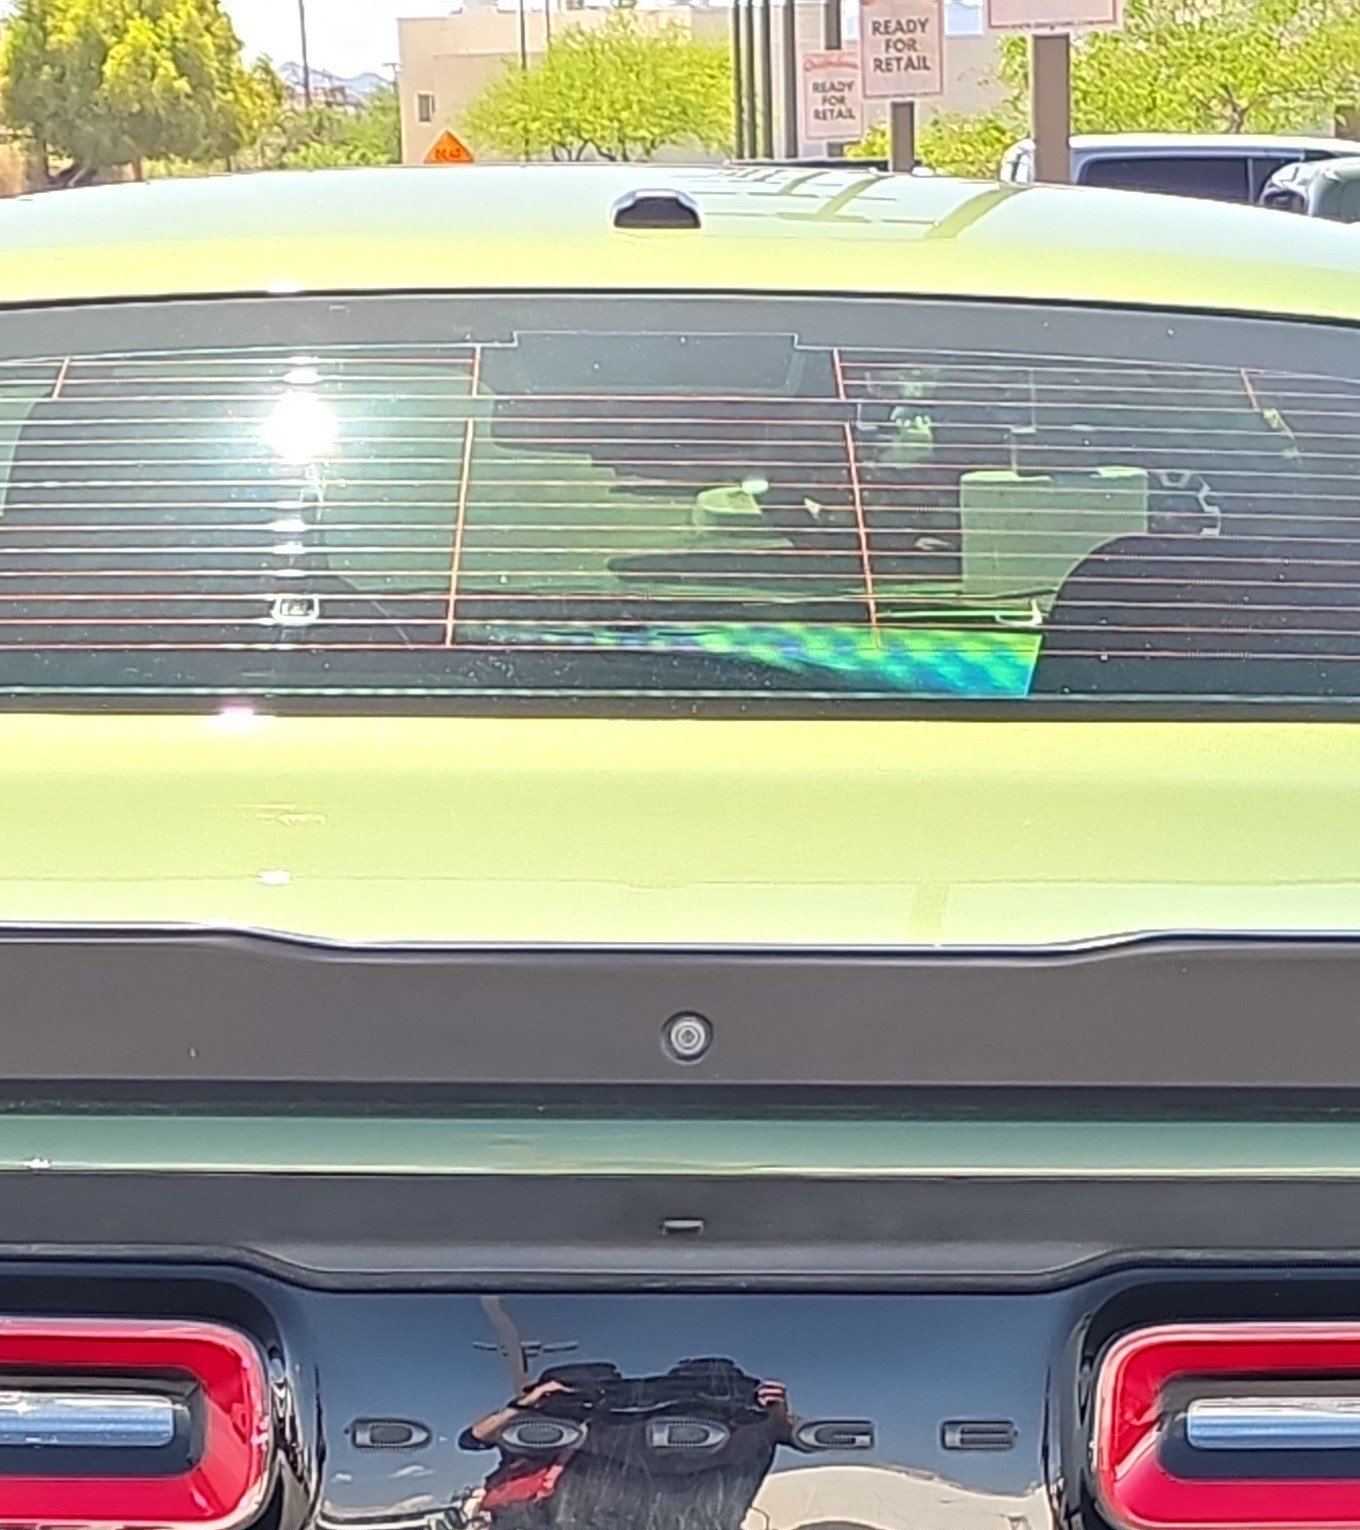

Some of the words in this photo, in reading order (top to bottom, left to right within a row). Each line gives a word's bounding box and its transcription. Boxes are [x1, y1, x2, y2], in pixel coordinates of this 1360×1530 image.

[871, 18, 929, 36] READY
[885, 38, 918, 53] FOR
[873, 55, 931, 73] RETAIL
[812, 81, 855, 93] READY
[822, 95, 846, 106] FOR
[814, 108, 856, 120] RETAIL
[351, 1416, 1017, 1451] DODGE
